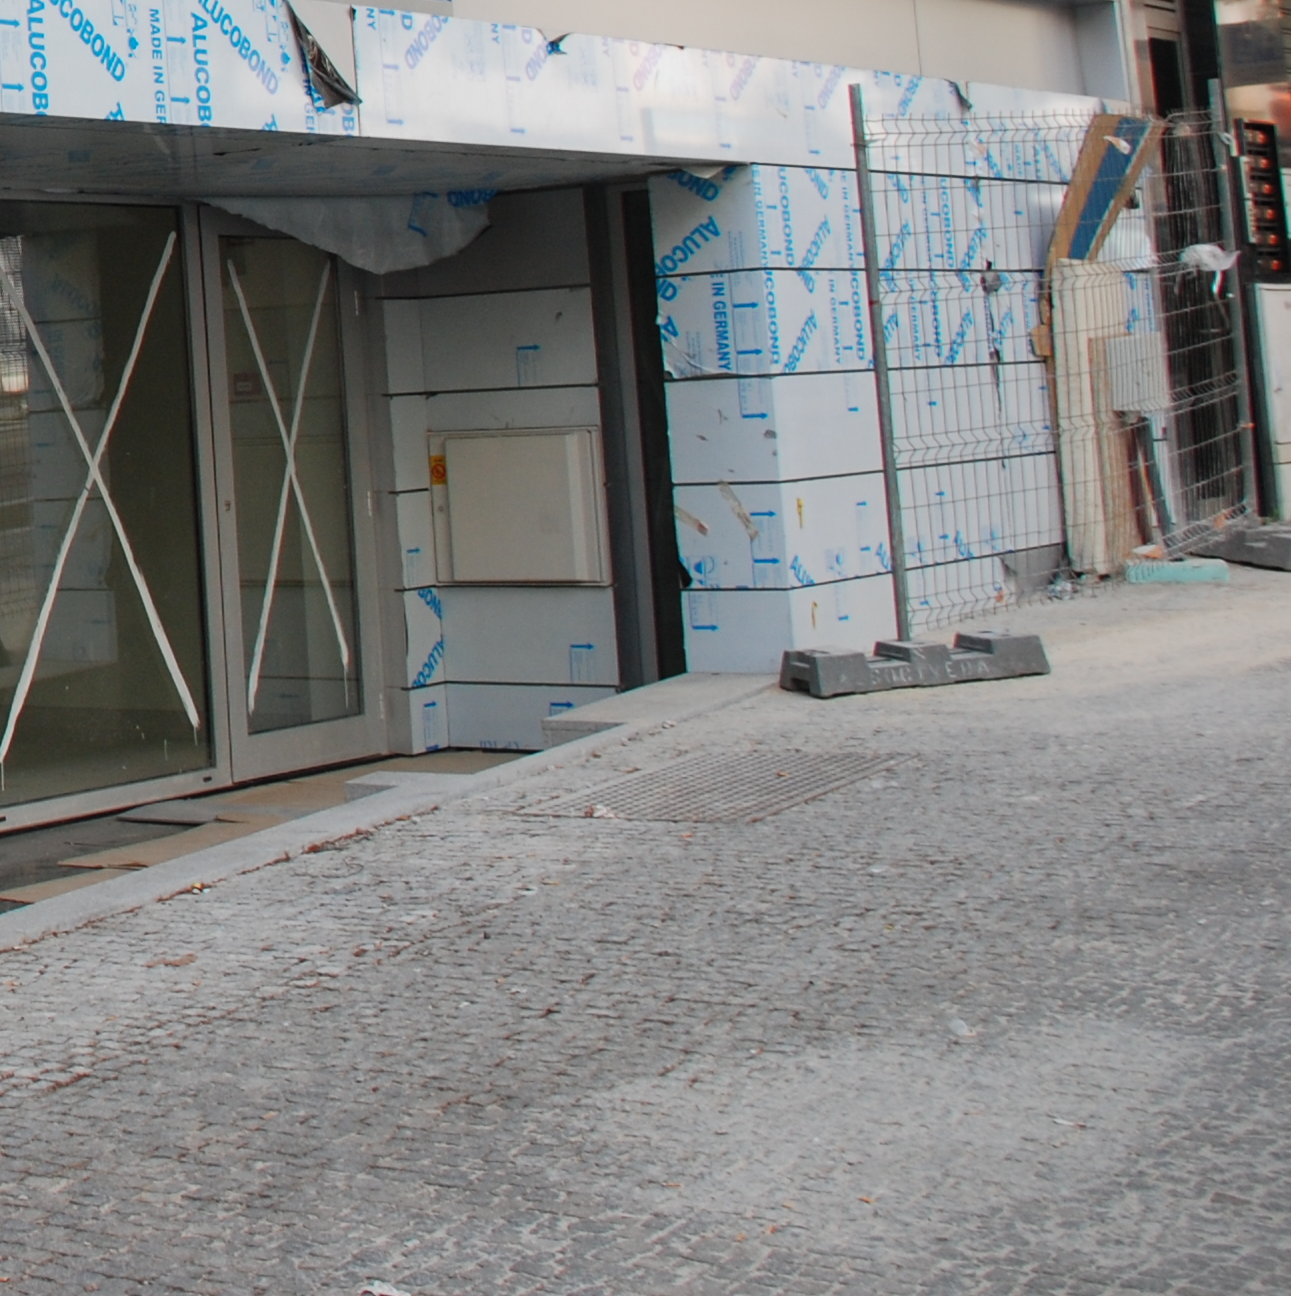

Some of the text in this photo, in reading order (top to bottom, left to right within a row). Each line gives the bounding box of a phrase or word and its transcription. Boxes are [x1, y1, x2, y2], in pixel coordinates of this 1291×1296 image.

[149, 8, 163, 60] MADE
[153, 65, 165, 84] IN
[713, 300, 733, 371] GERMANY
